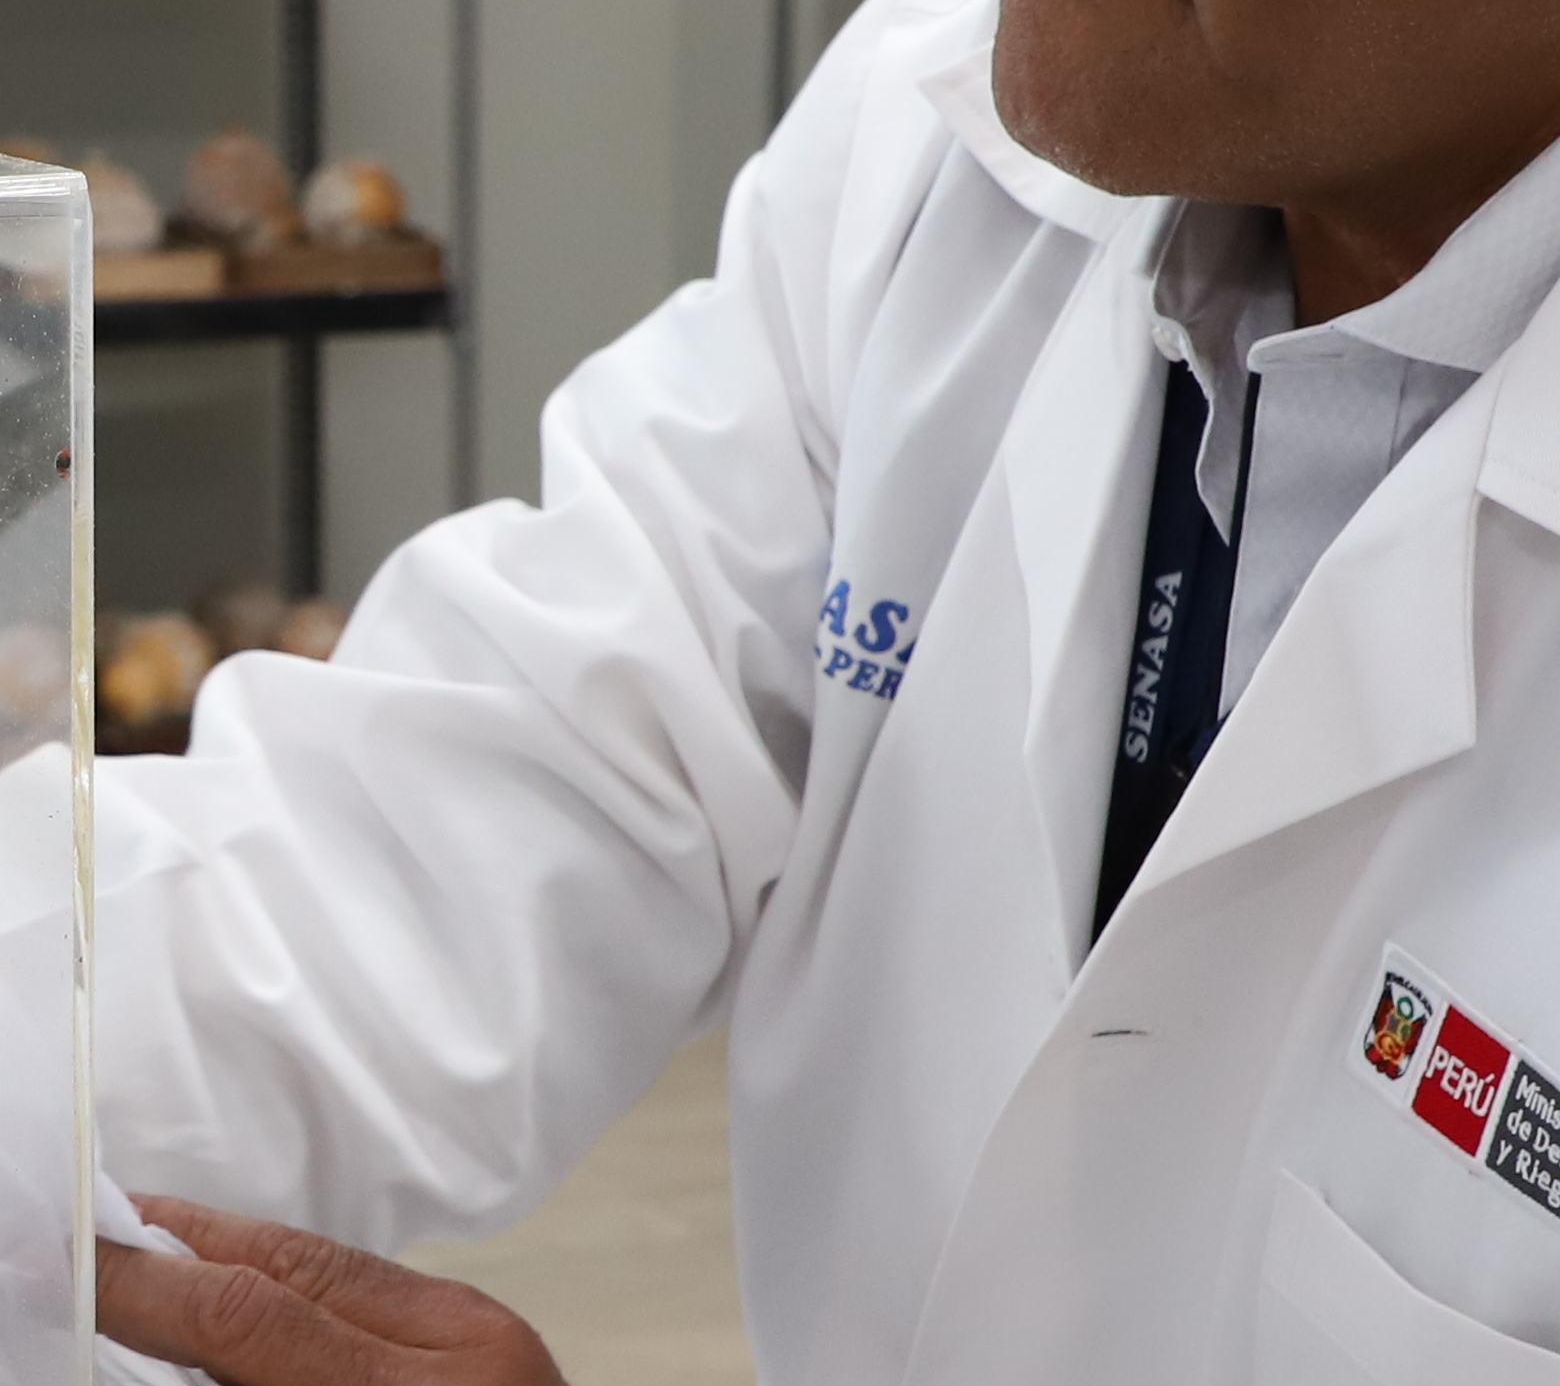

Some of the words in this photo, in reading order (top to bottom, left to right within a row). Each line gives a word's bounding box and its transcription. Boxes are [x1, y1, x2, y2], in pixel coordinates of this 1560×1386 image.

[820, 578, 917, 665] AS
[1125, 570, 1183, 763] SENASA
[1425, 1045, 1495, 1117] PERÚ
[1496, 1139, 1513, 1167] y
[1507, 1109, 1533, 1142] de
